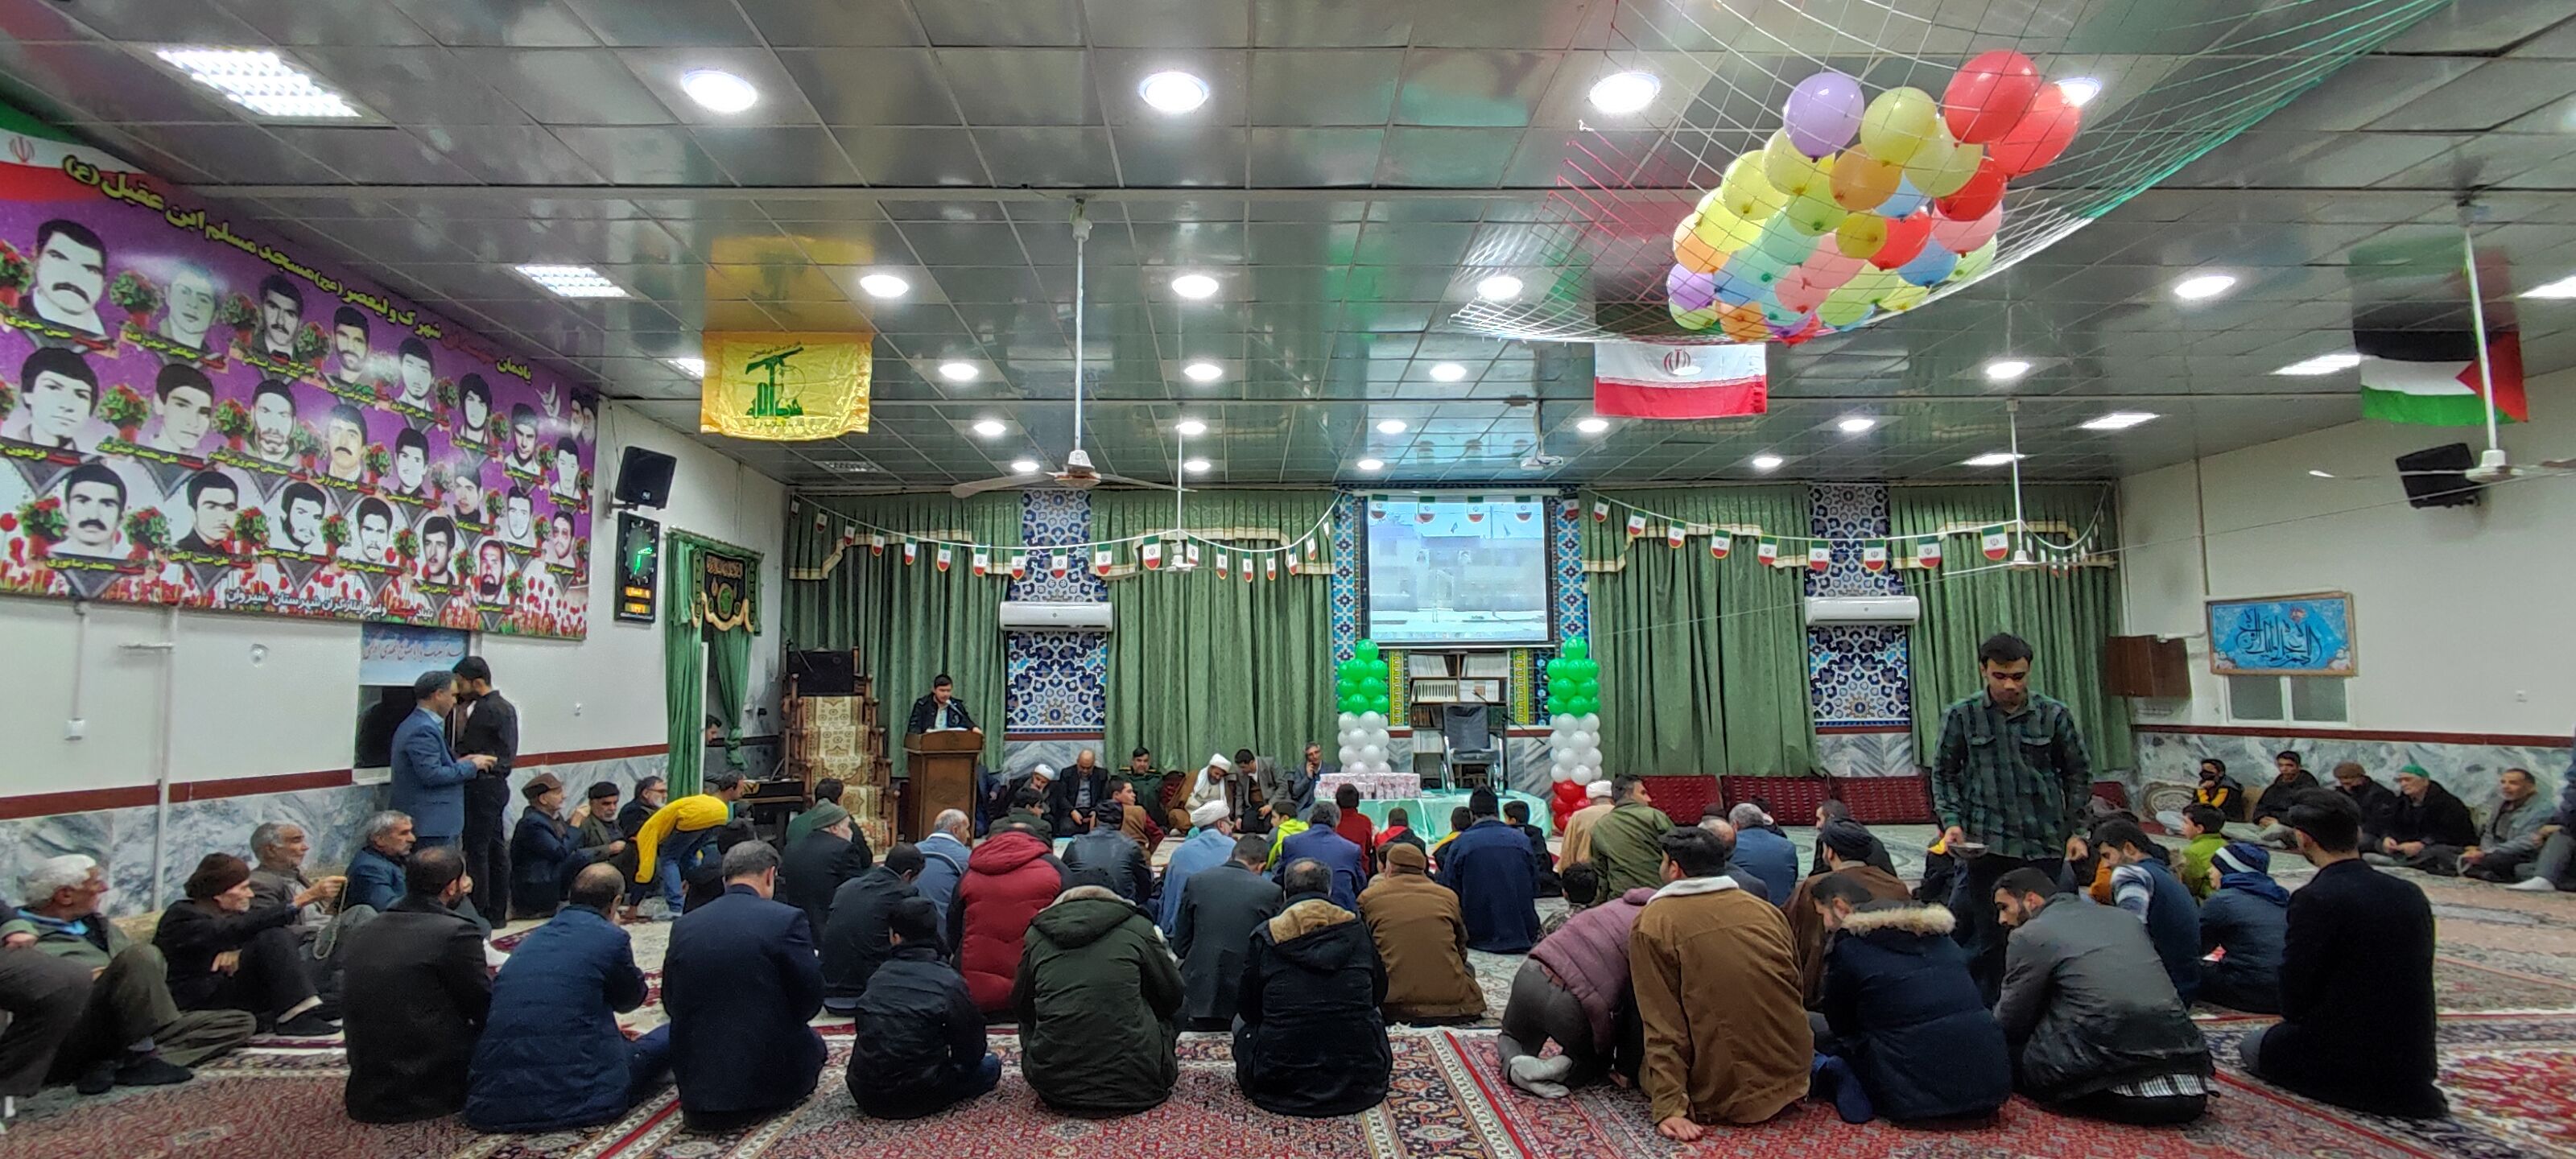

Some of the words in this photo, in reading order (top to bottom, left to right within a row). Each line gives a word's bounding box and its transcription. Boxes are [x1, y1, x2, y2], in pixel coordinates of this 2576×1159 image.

[62, 154, 101, 187] (ع)
[100, 171, 166, 212] عقیل
[165, 205, 206, 233] ابن
[204, 220, 258, 254] مسلم
[258, 245, 315, 282] مسجد
[496, 357, 532, 385] یادمان
[225, 588, 269, 604] شیروان
[271, 590, 322, 609] شهرستان
[415, 606, 435, 620] بنیاد
